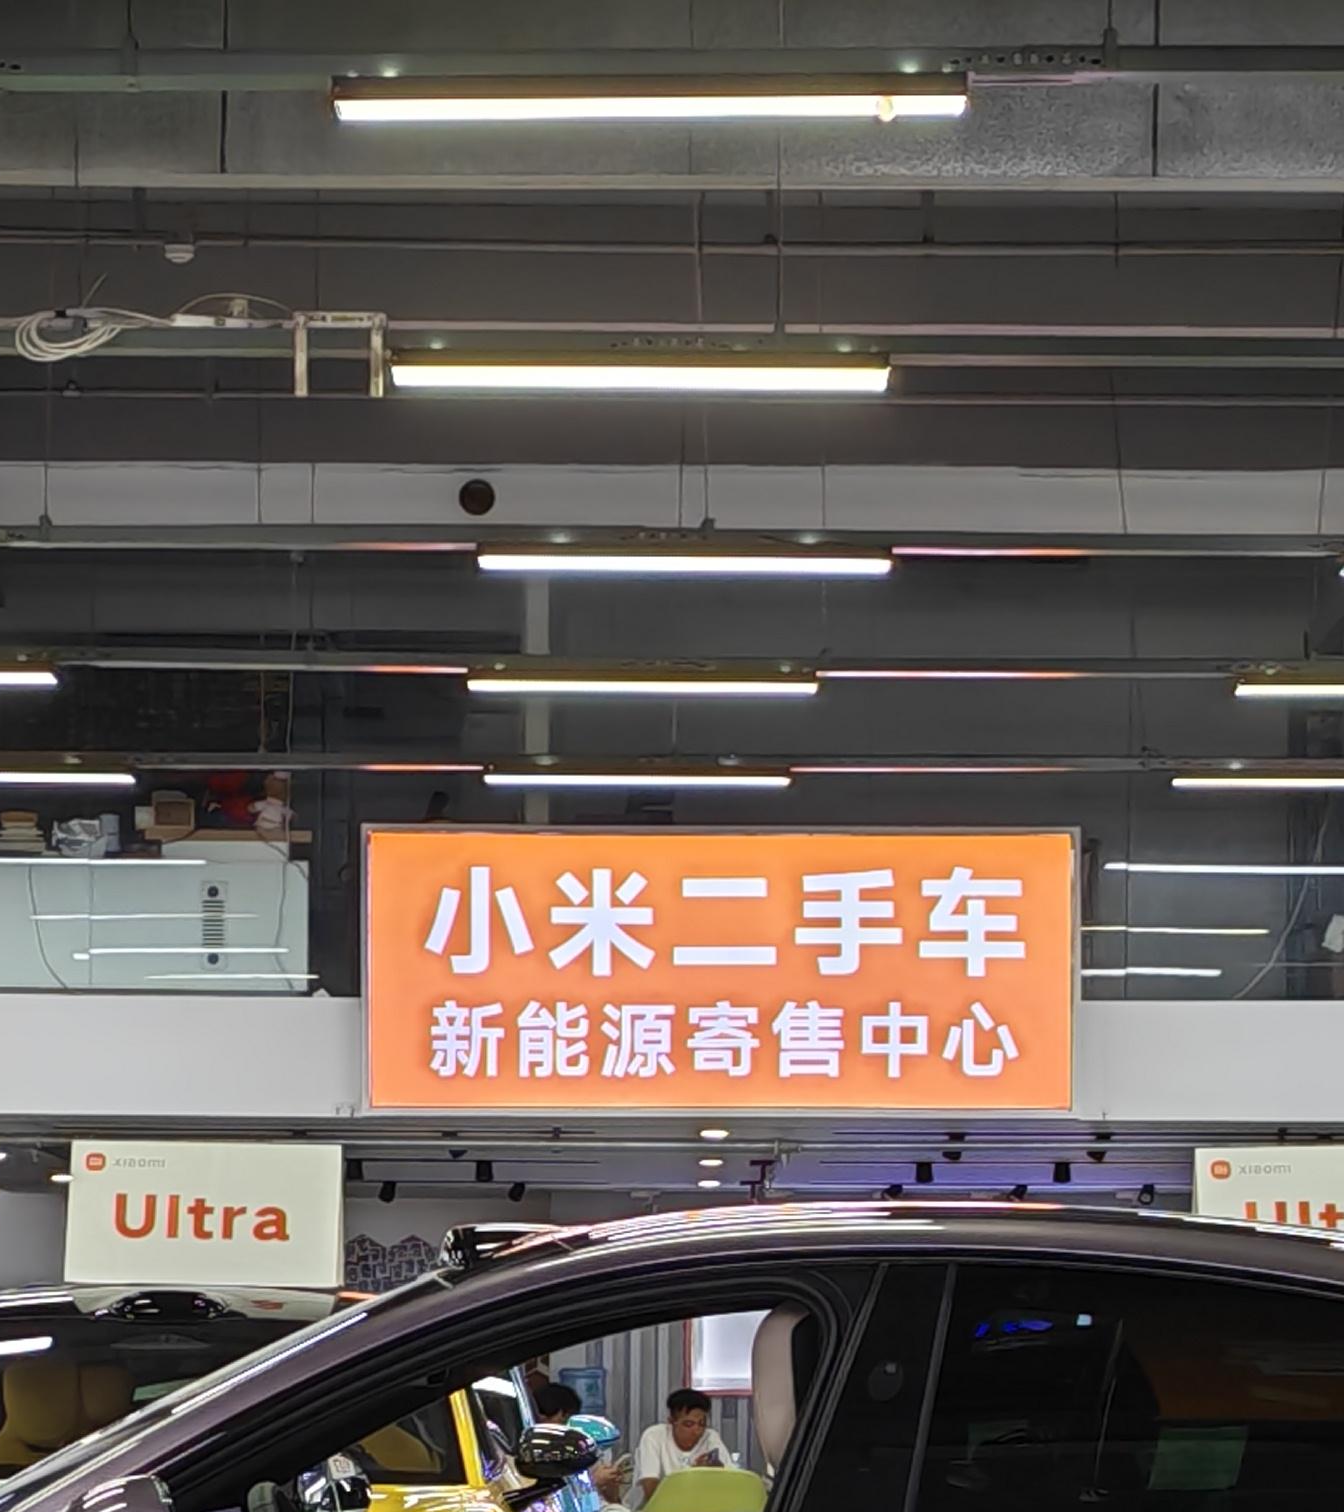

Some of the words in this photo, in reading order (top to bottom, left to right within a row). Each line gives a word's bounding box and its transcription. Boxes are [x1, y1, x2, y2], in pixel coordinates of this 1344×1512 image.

[424, 866, 1026, 977] 小米二手车
[430, 1001, 1019, 1079] 新能源寄售中心
[114, 1192, 291, 1241] Ultra
